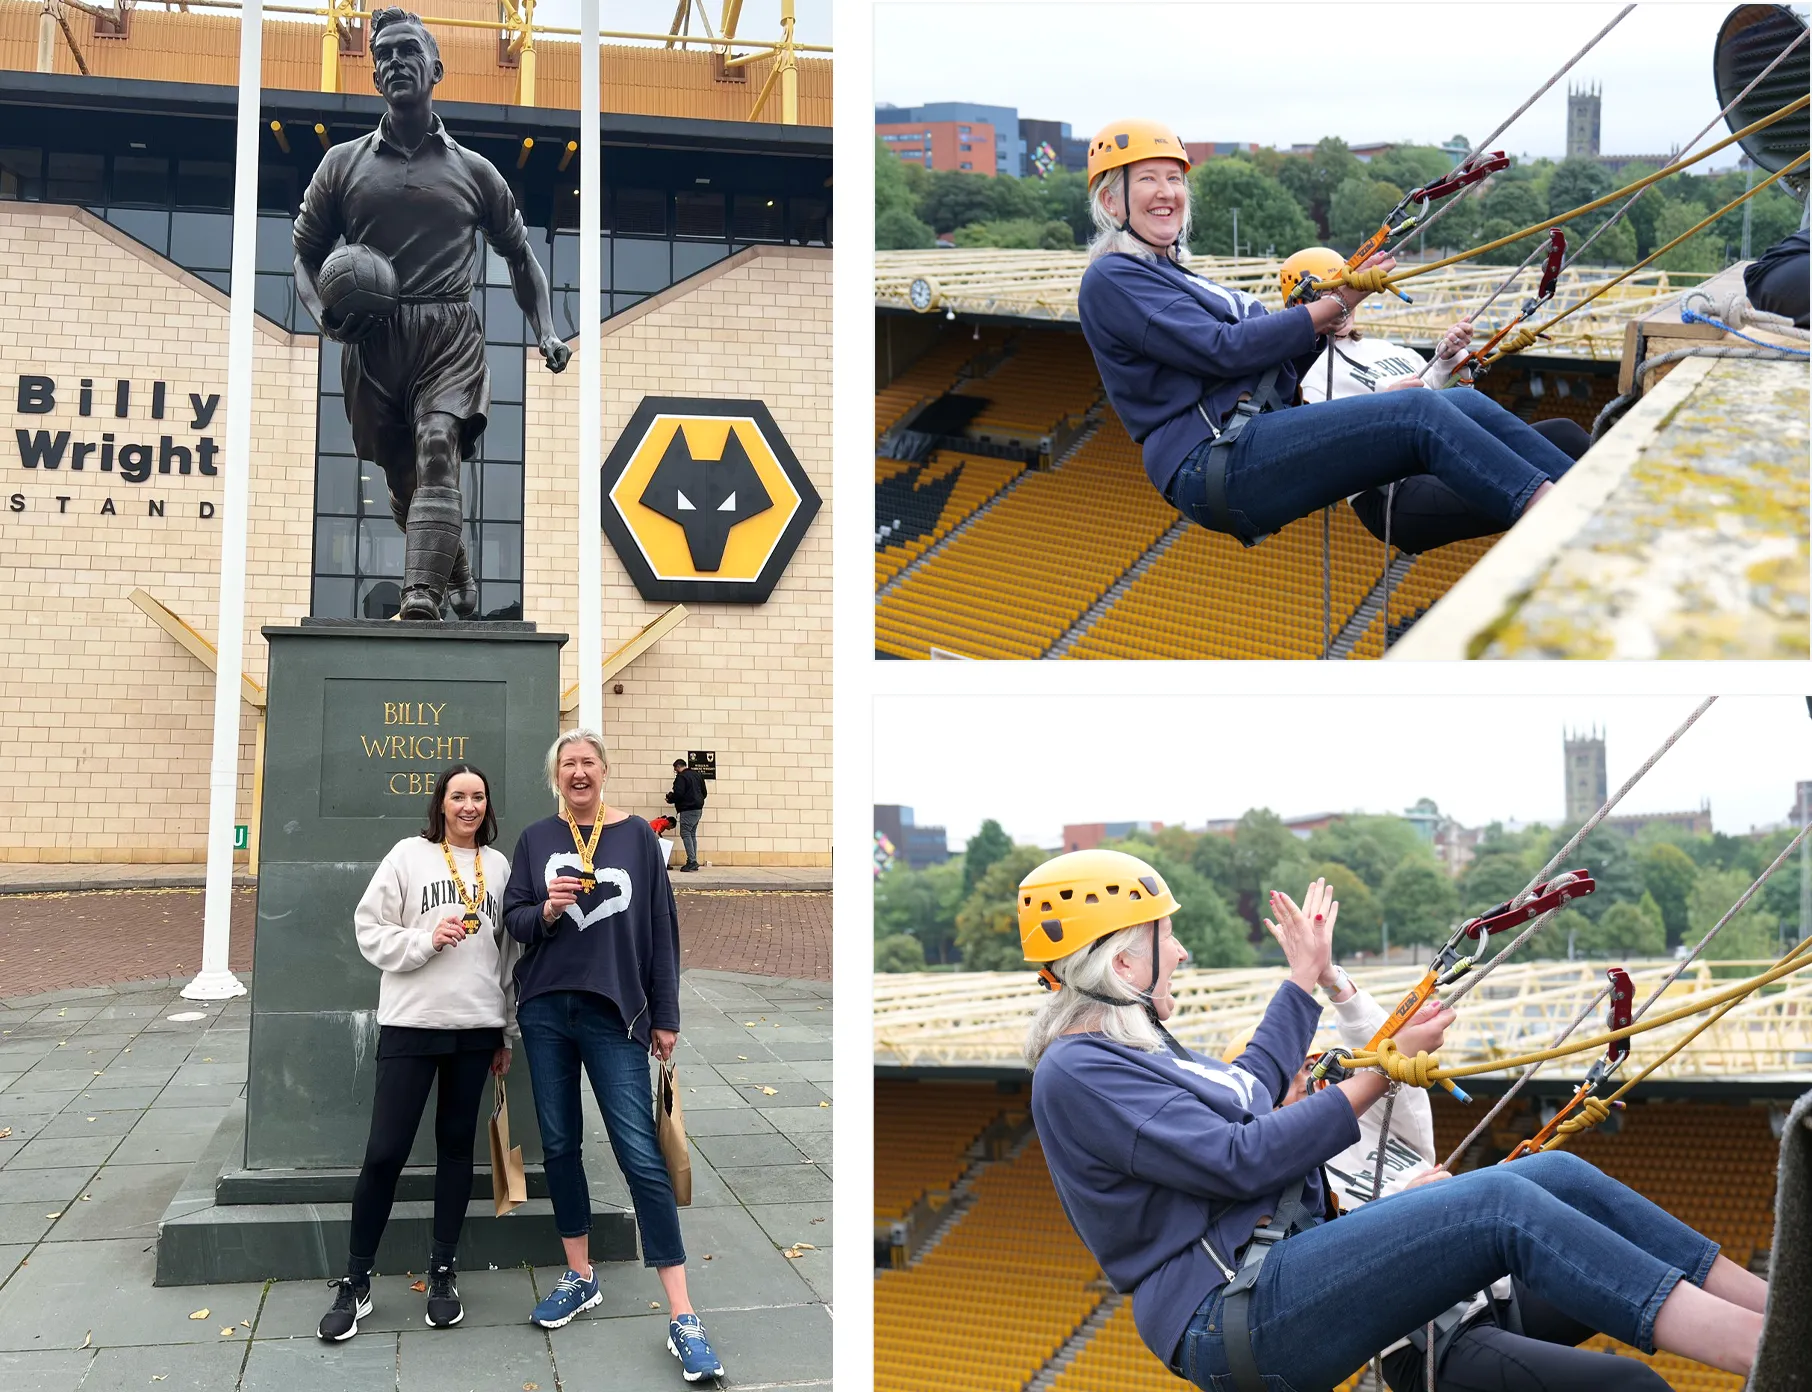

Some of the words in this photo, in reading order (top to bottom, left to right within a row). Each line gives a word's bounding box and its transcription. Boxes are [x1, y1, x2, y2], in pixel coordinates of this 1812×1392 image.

[17, 375, 220, 430] Billy
[15, 429, 219, 483] Wright
[10, 493, 215, 519] STAND
[384, 702, 447, 726] BILLY
[360, 735, 469, 760] WRIGHT
[389, 773, 435, 795] CBE
